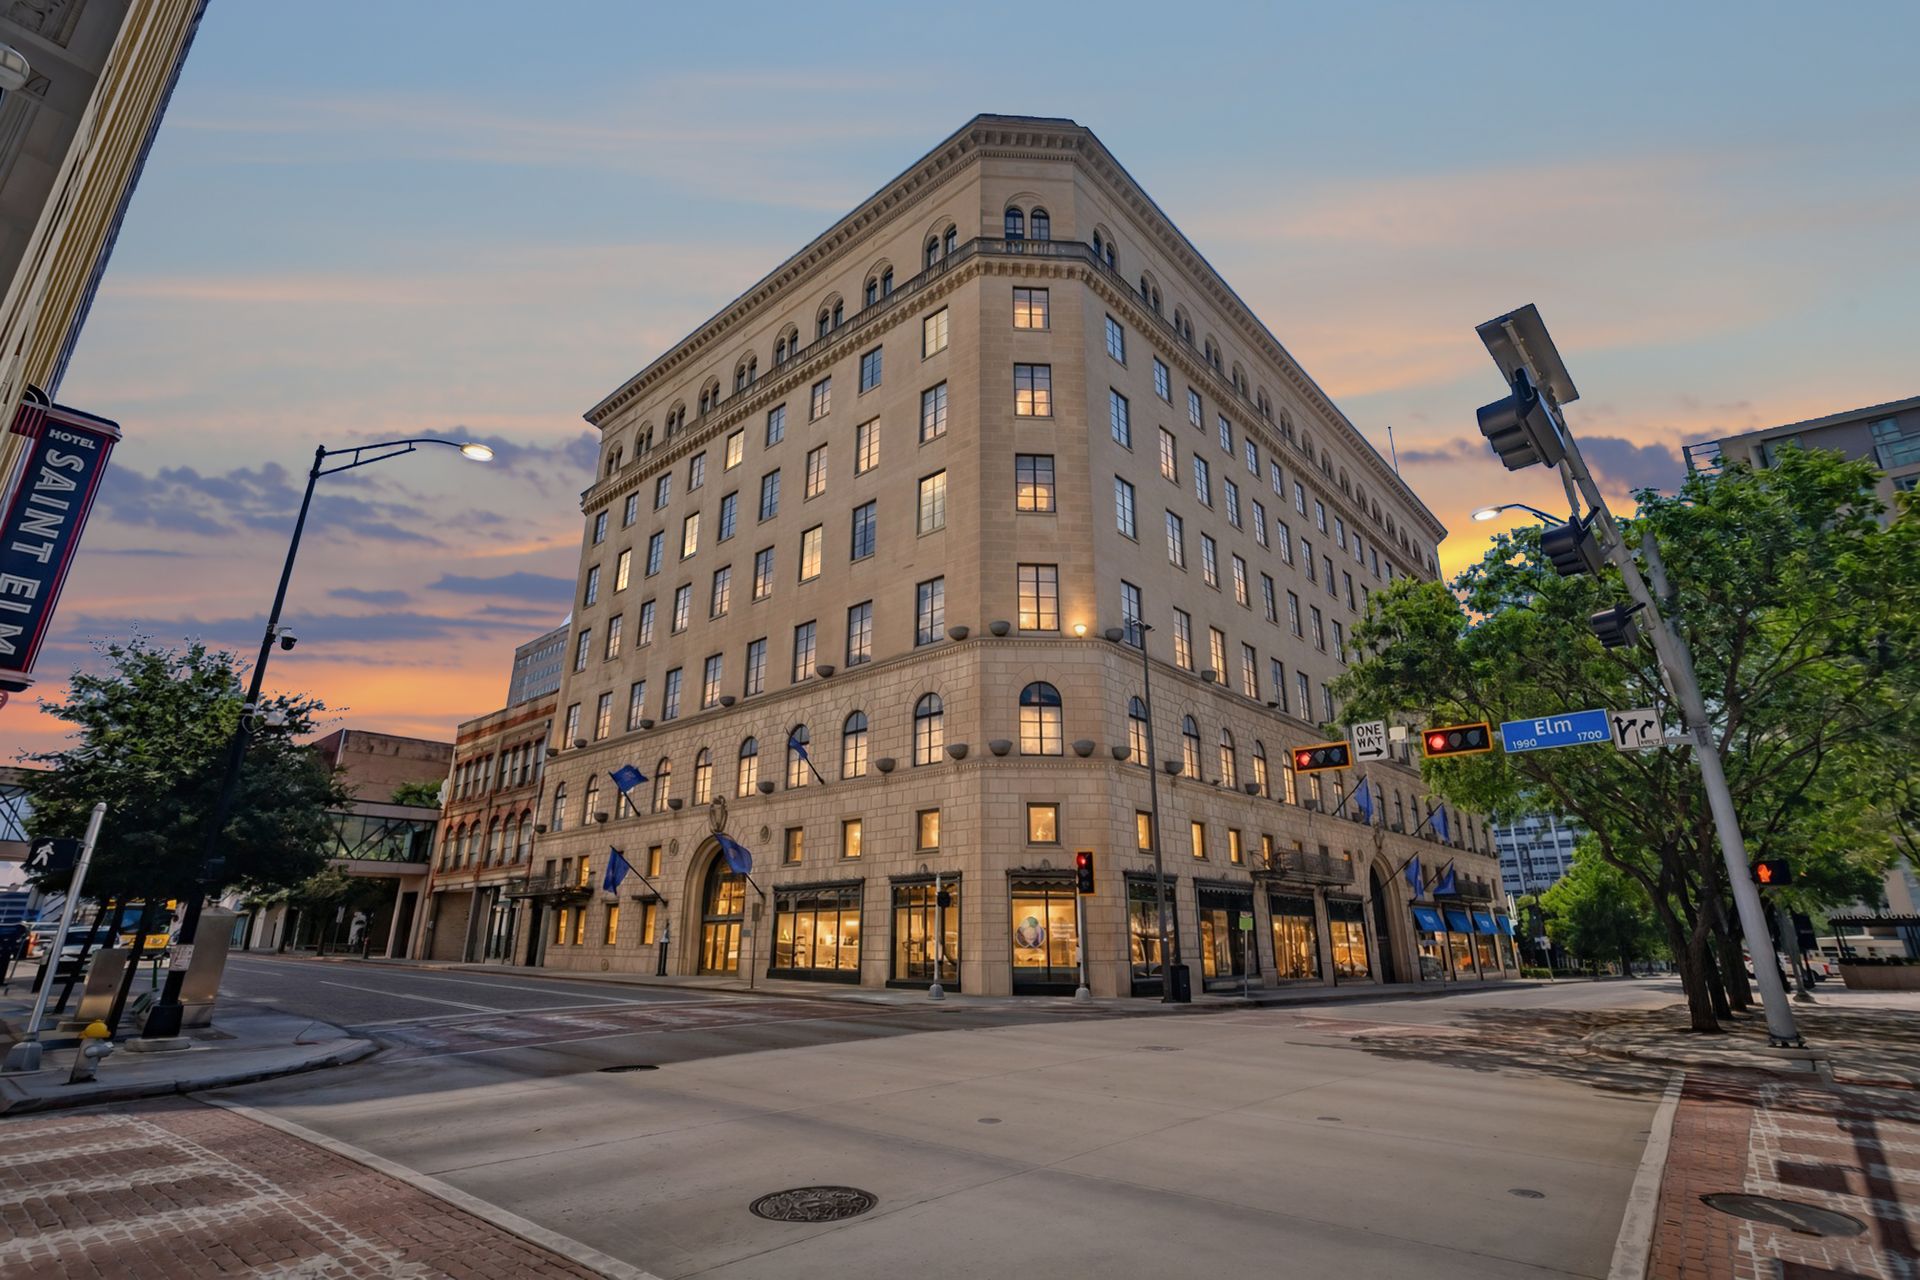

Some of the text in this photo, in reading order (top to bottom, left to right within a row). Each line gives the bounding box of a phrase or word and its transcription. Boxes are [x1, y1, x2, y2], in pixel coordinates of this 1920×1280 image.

[49, 429, 96, 450] HOTEL
[11, 448, 85, 564] SAINT
[1356, 724, 1382, 737] ONE
[1534, 719, 1572, 736] Elm
[1357, 736, 1383, 748] WAY
[1512, 730, 1602, 749] 1990 1700
